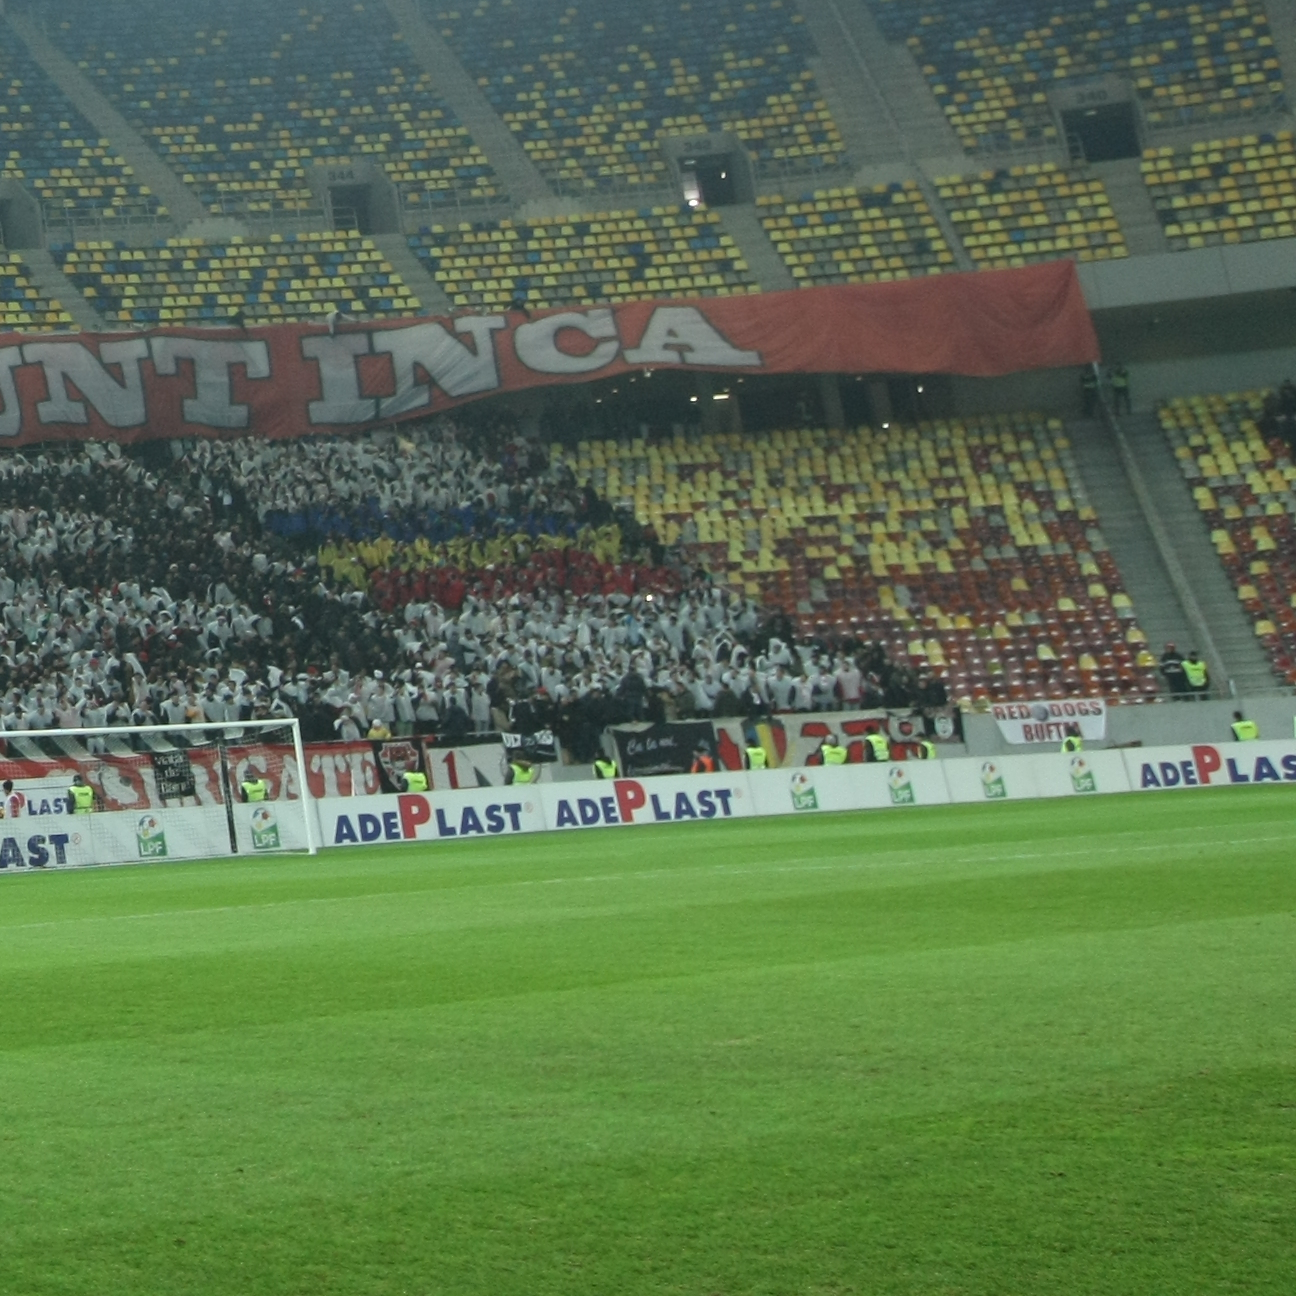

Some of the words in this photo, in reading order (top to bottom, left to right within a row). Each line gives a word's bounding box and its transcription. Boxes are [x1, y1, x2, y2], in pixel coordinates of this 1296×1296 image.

[301, 305, 762, 425] INCA
[992, 704, 1031, 720] RED
[1048, 700, 1103, 717] DOGS
[334, 794, 522, 844] ADEPLAST
[555, 780, 732, 828] ADEPLAST
